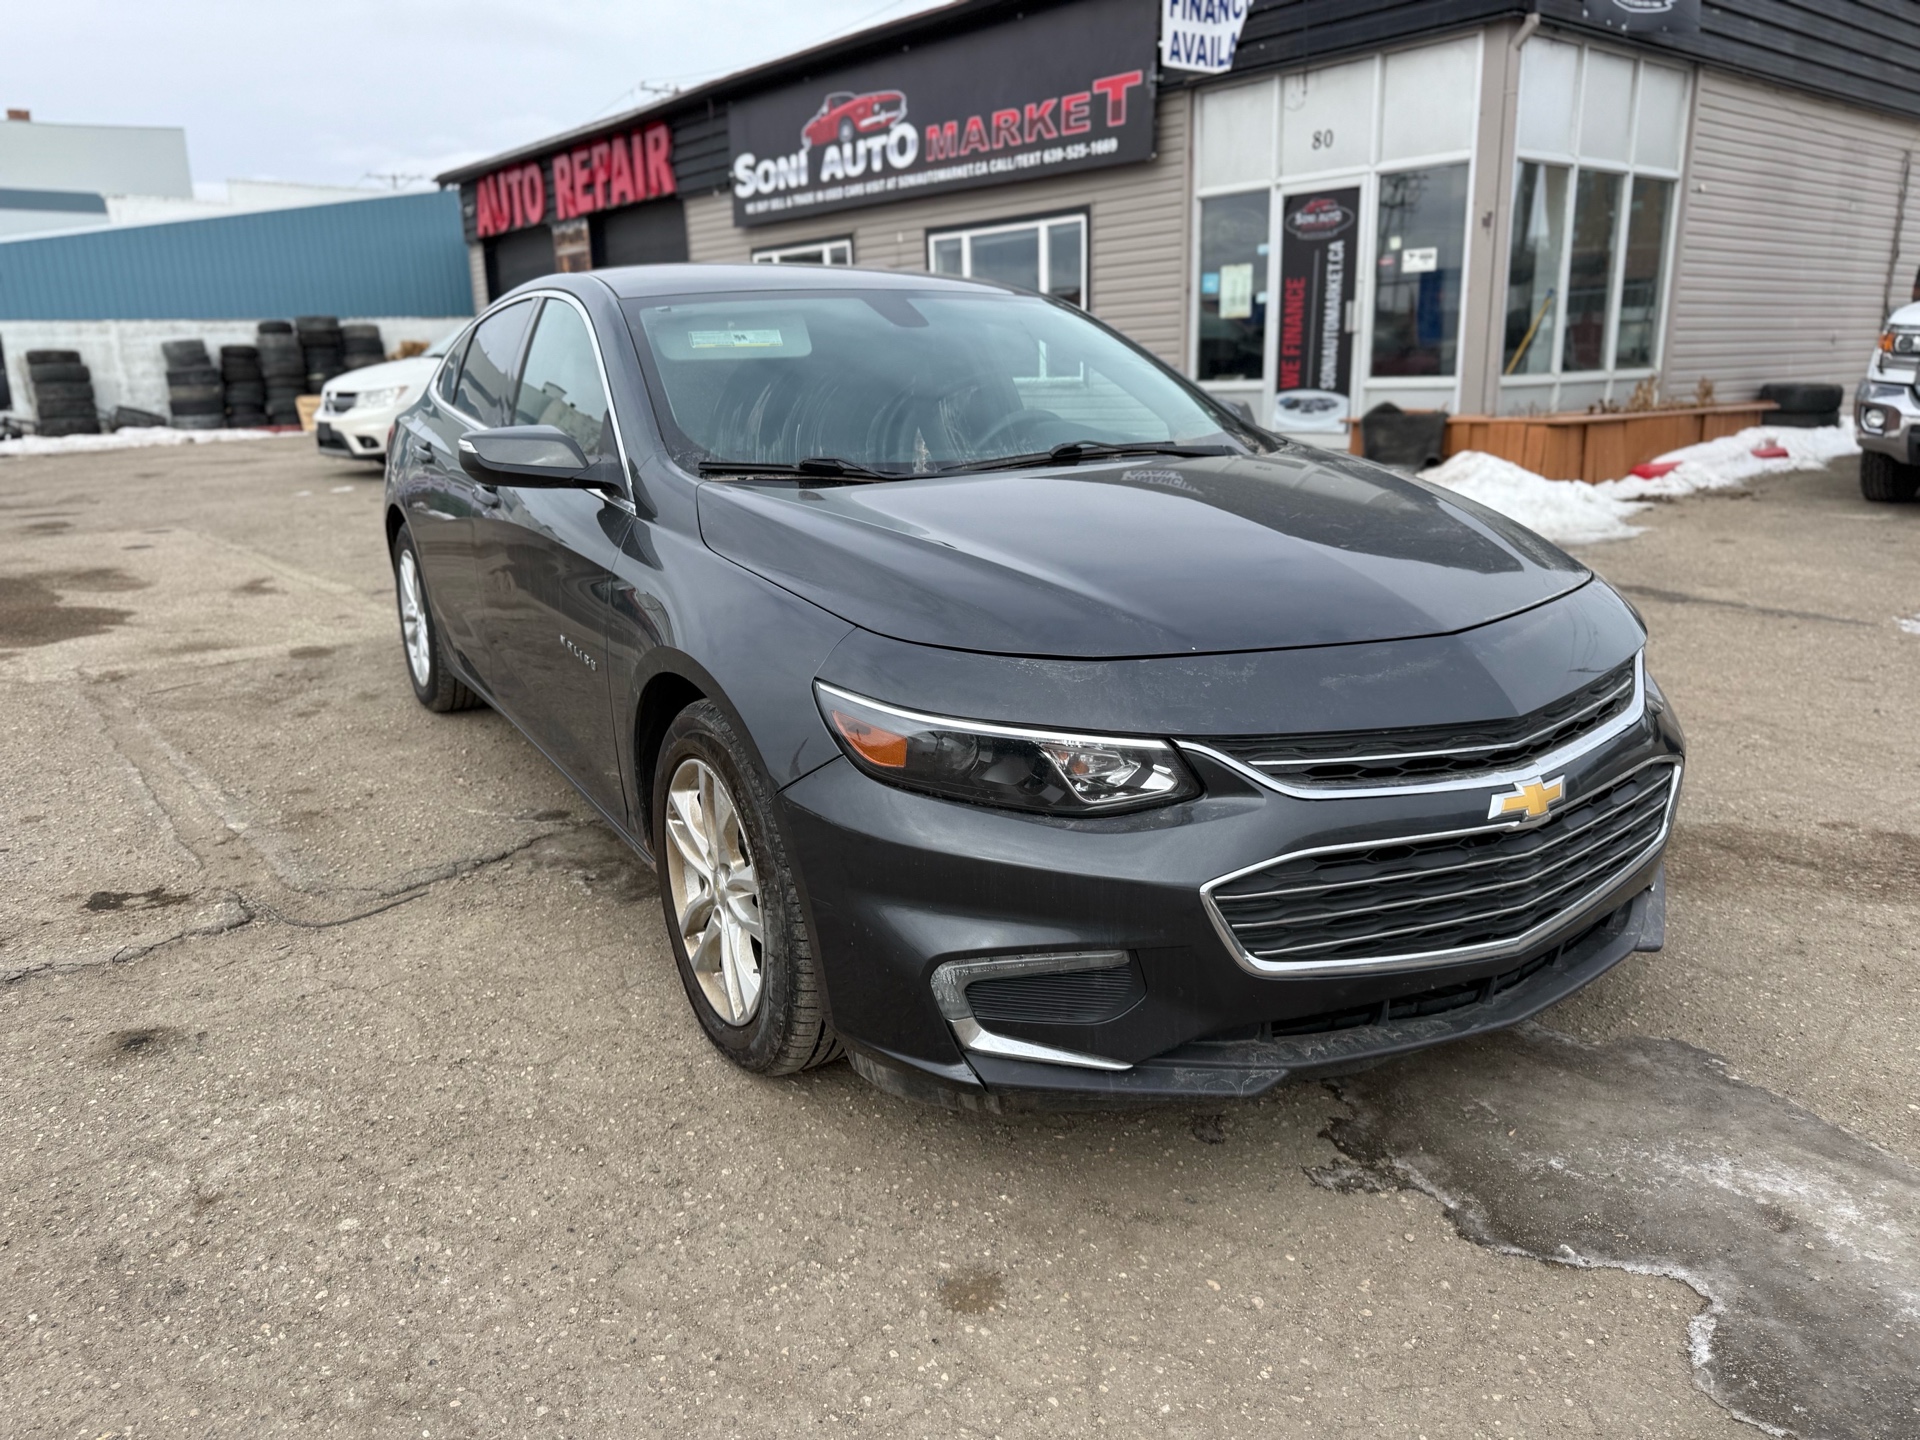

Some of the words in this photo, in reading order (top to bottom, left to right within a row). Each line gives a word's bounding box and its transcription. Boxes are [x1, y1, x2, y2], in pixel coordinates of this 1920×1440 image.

[820, 122, 919, 182] AUTO
[925, 69, 1143, 162] MARKET
[1312, 129, 1334, 150] 80
[476, 160, 546, 238] AUTO
[552, 120, 677, 221] REPAIR
[1282, 276, 1306, 356] FINANCE
[1319, 239, 1345, 390] SONIAUTOMARKET.CA
[1280, 360, 1301, 389] WE
[560, 634, 596, 671] MALIBU
